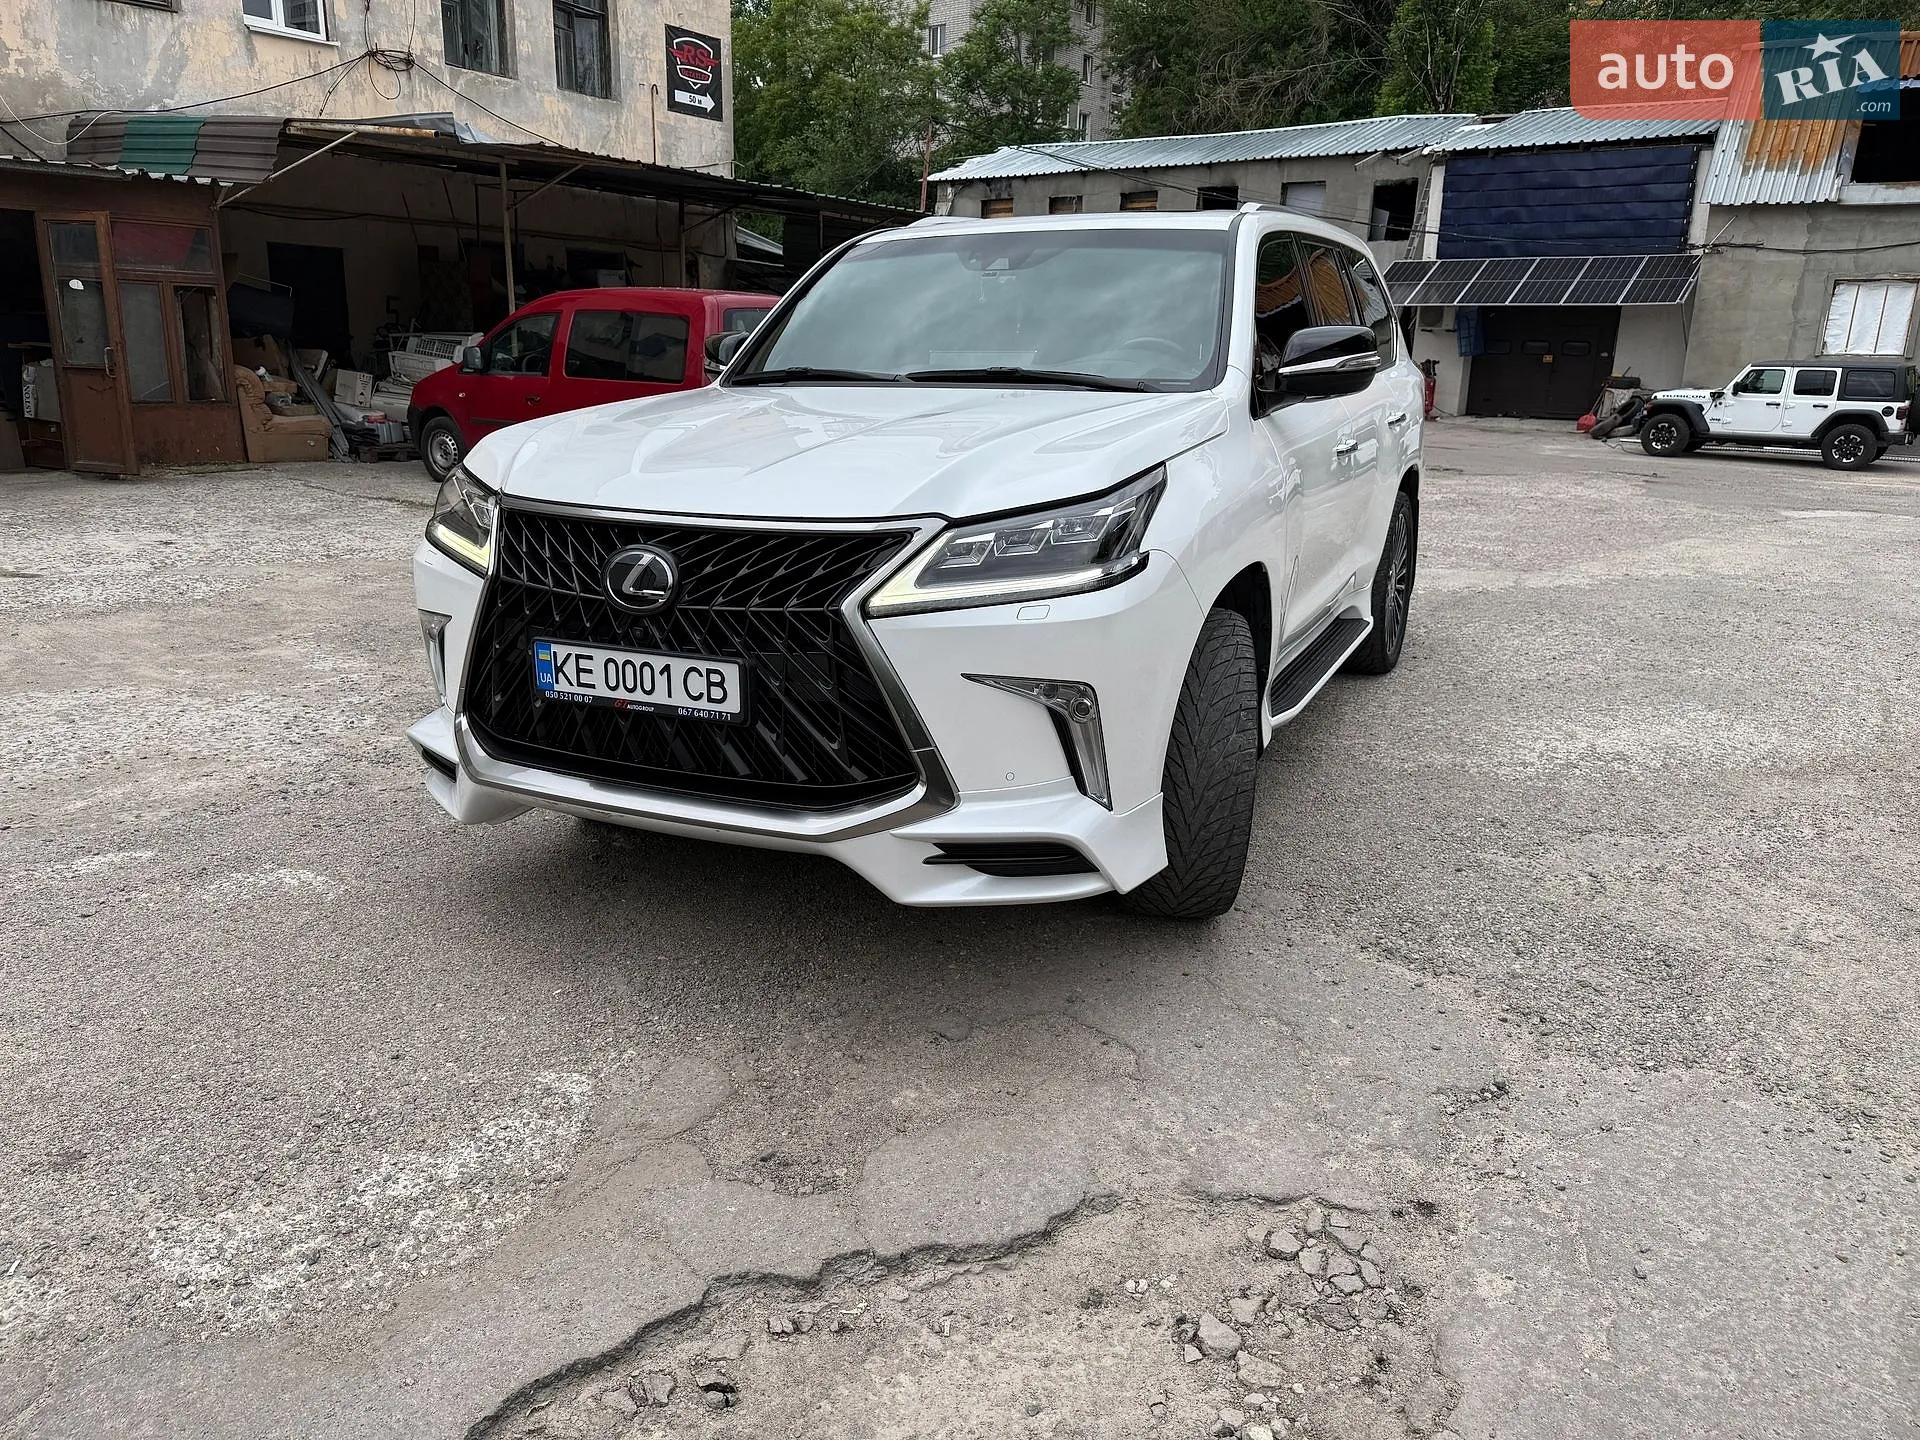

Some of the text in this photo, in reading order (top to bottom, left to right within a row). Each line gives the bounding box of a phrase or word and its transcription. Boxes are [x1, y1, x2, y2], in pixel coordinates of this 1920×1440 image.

[688, 94, 697, 104] 50
[540, 672, 553, 684] UA
[553, 651, 728, 704] KE 0001 CB
[545, 690, 593, 704] 050 521 00 07
[678, 707, 731, 721] 067 640 71 71
